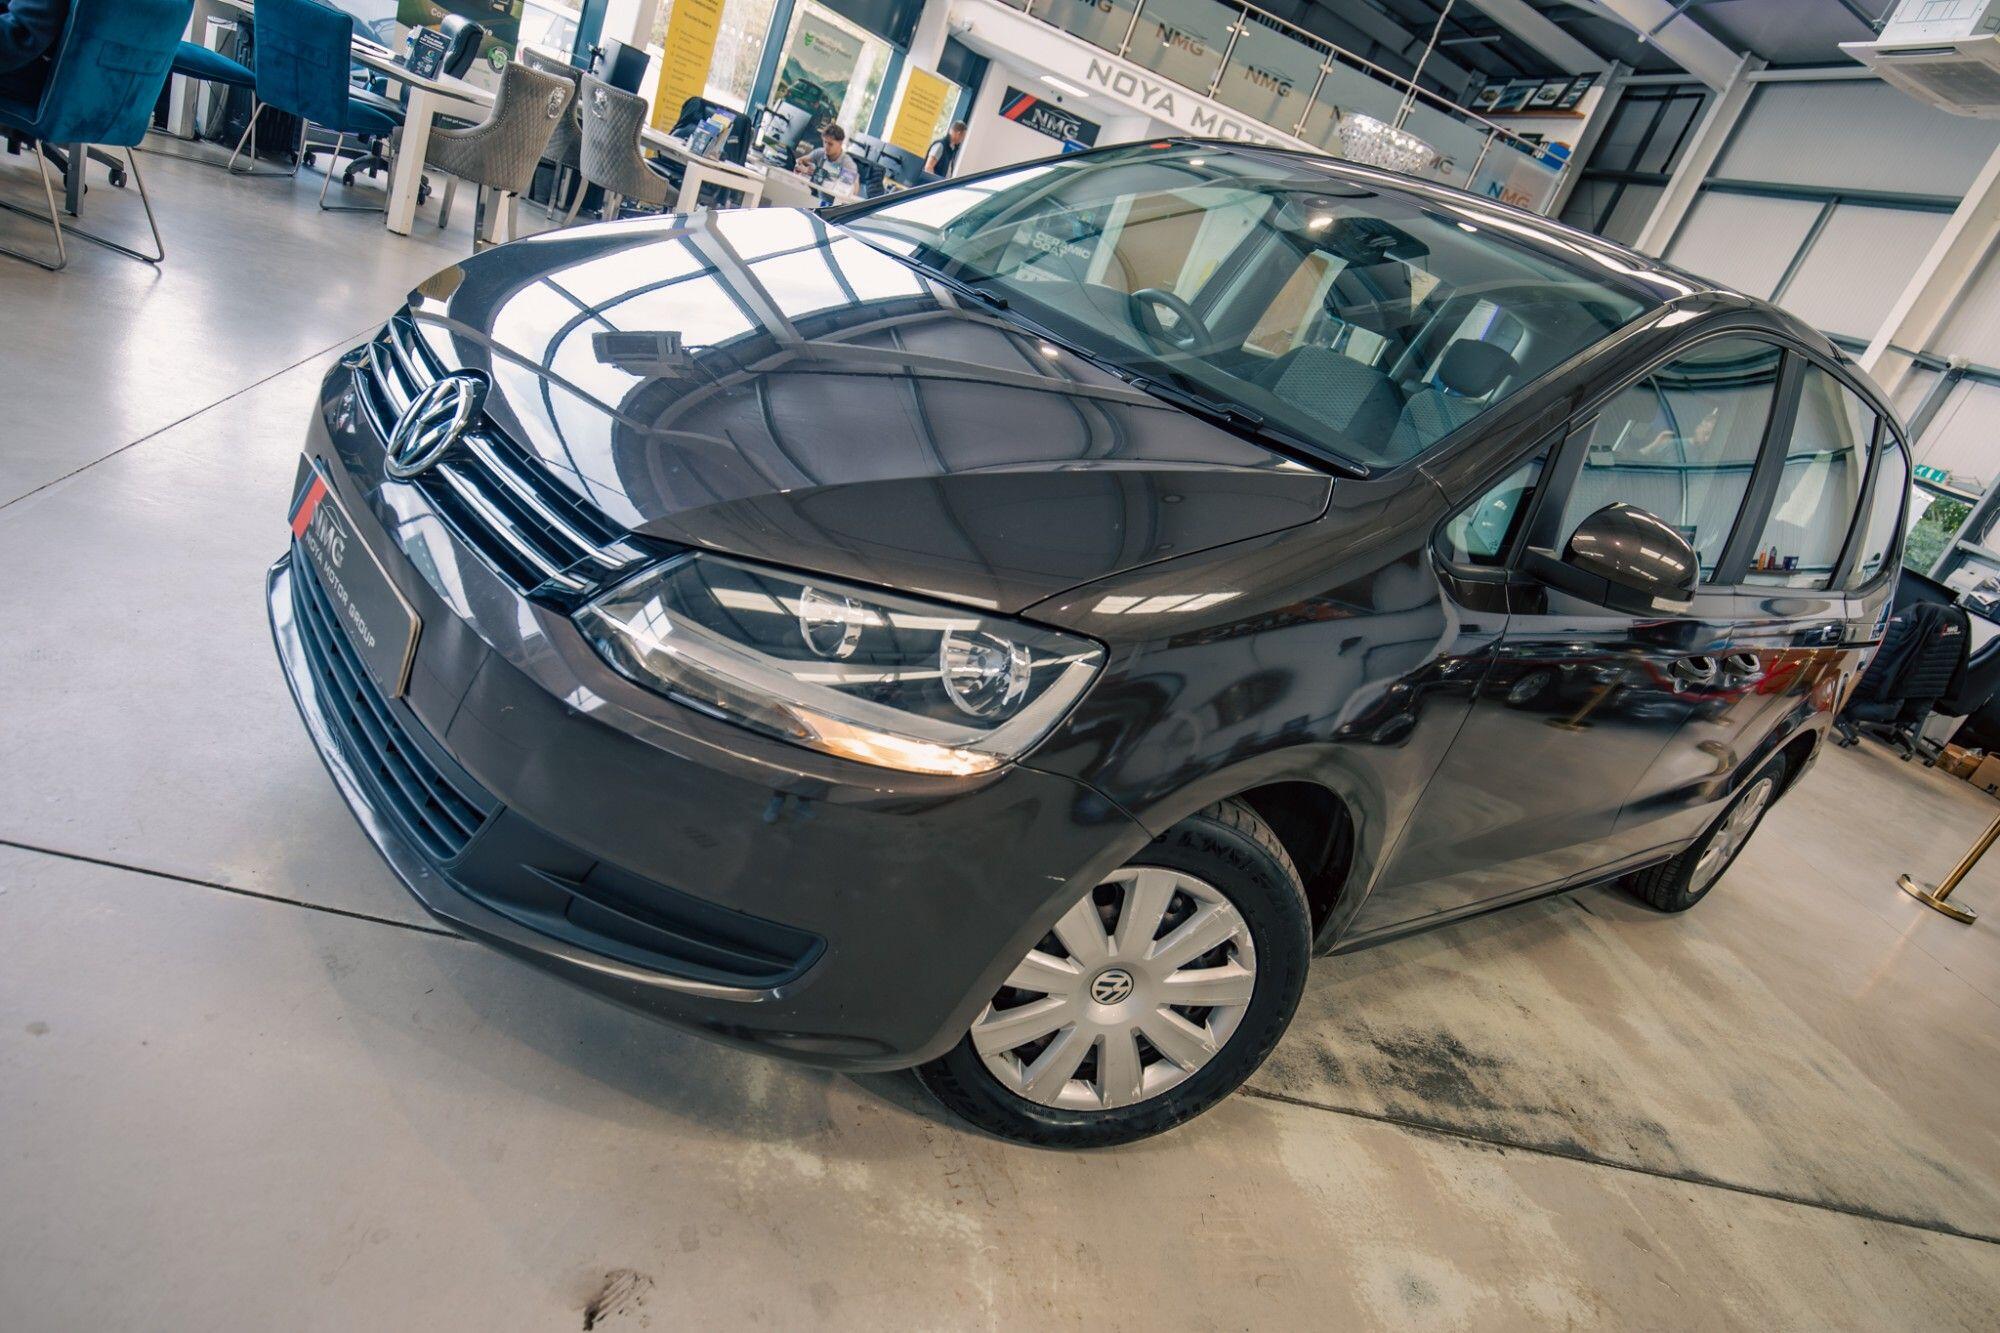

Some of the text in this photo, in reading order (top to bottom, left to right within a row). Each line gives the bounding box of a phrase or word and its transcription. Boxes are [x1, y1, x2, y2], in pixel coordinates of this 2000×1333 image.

[1156, 22, 1204, 56] NMG
[1087, 58, 1174, 116] NOYA
[1245, 65, 1292, 97] NMG
[1032, 108, 1079, 139] NMG
[1488, 181, 1530, 208] NMG
[310, 500, 345, 568] NMG
[304, 530, 375, 648] NOYA MOTOR GROUP
